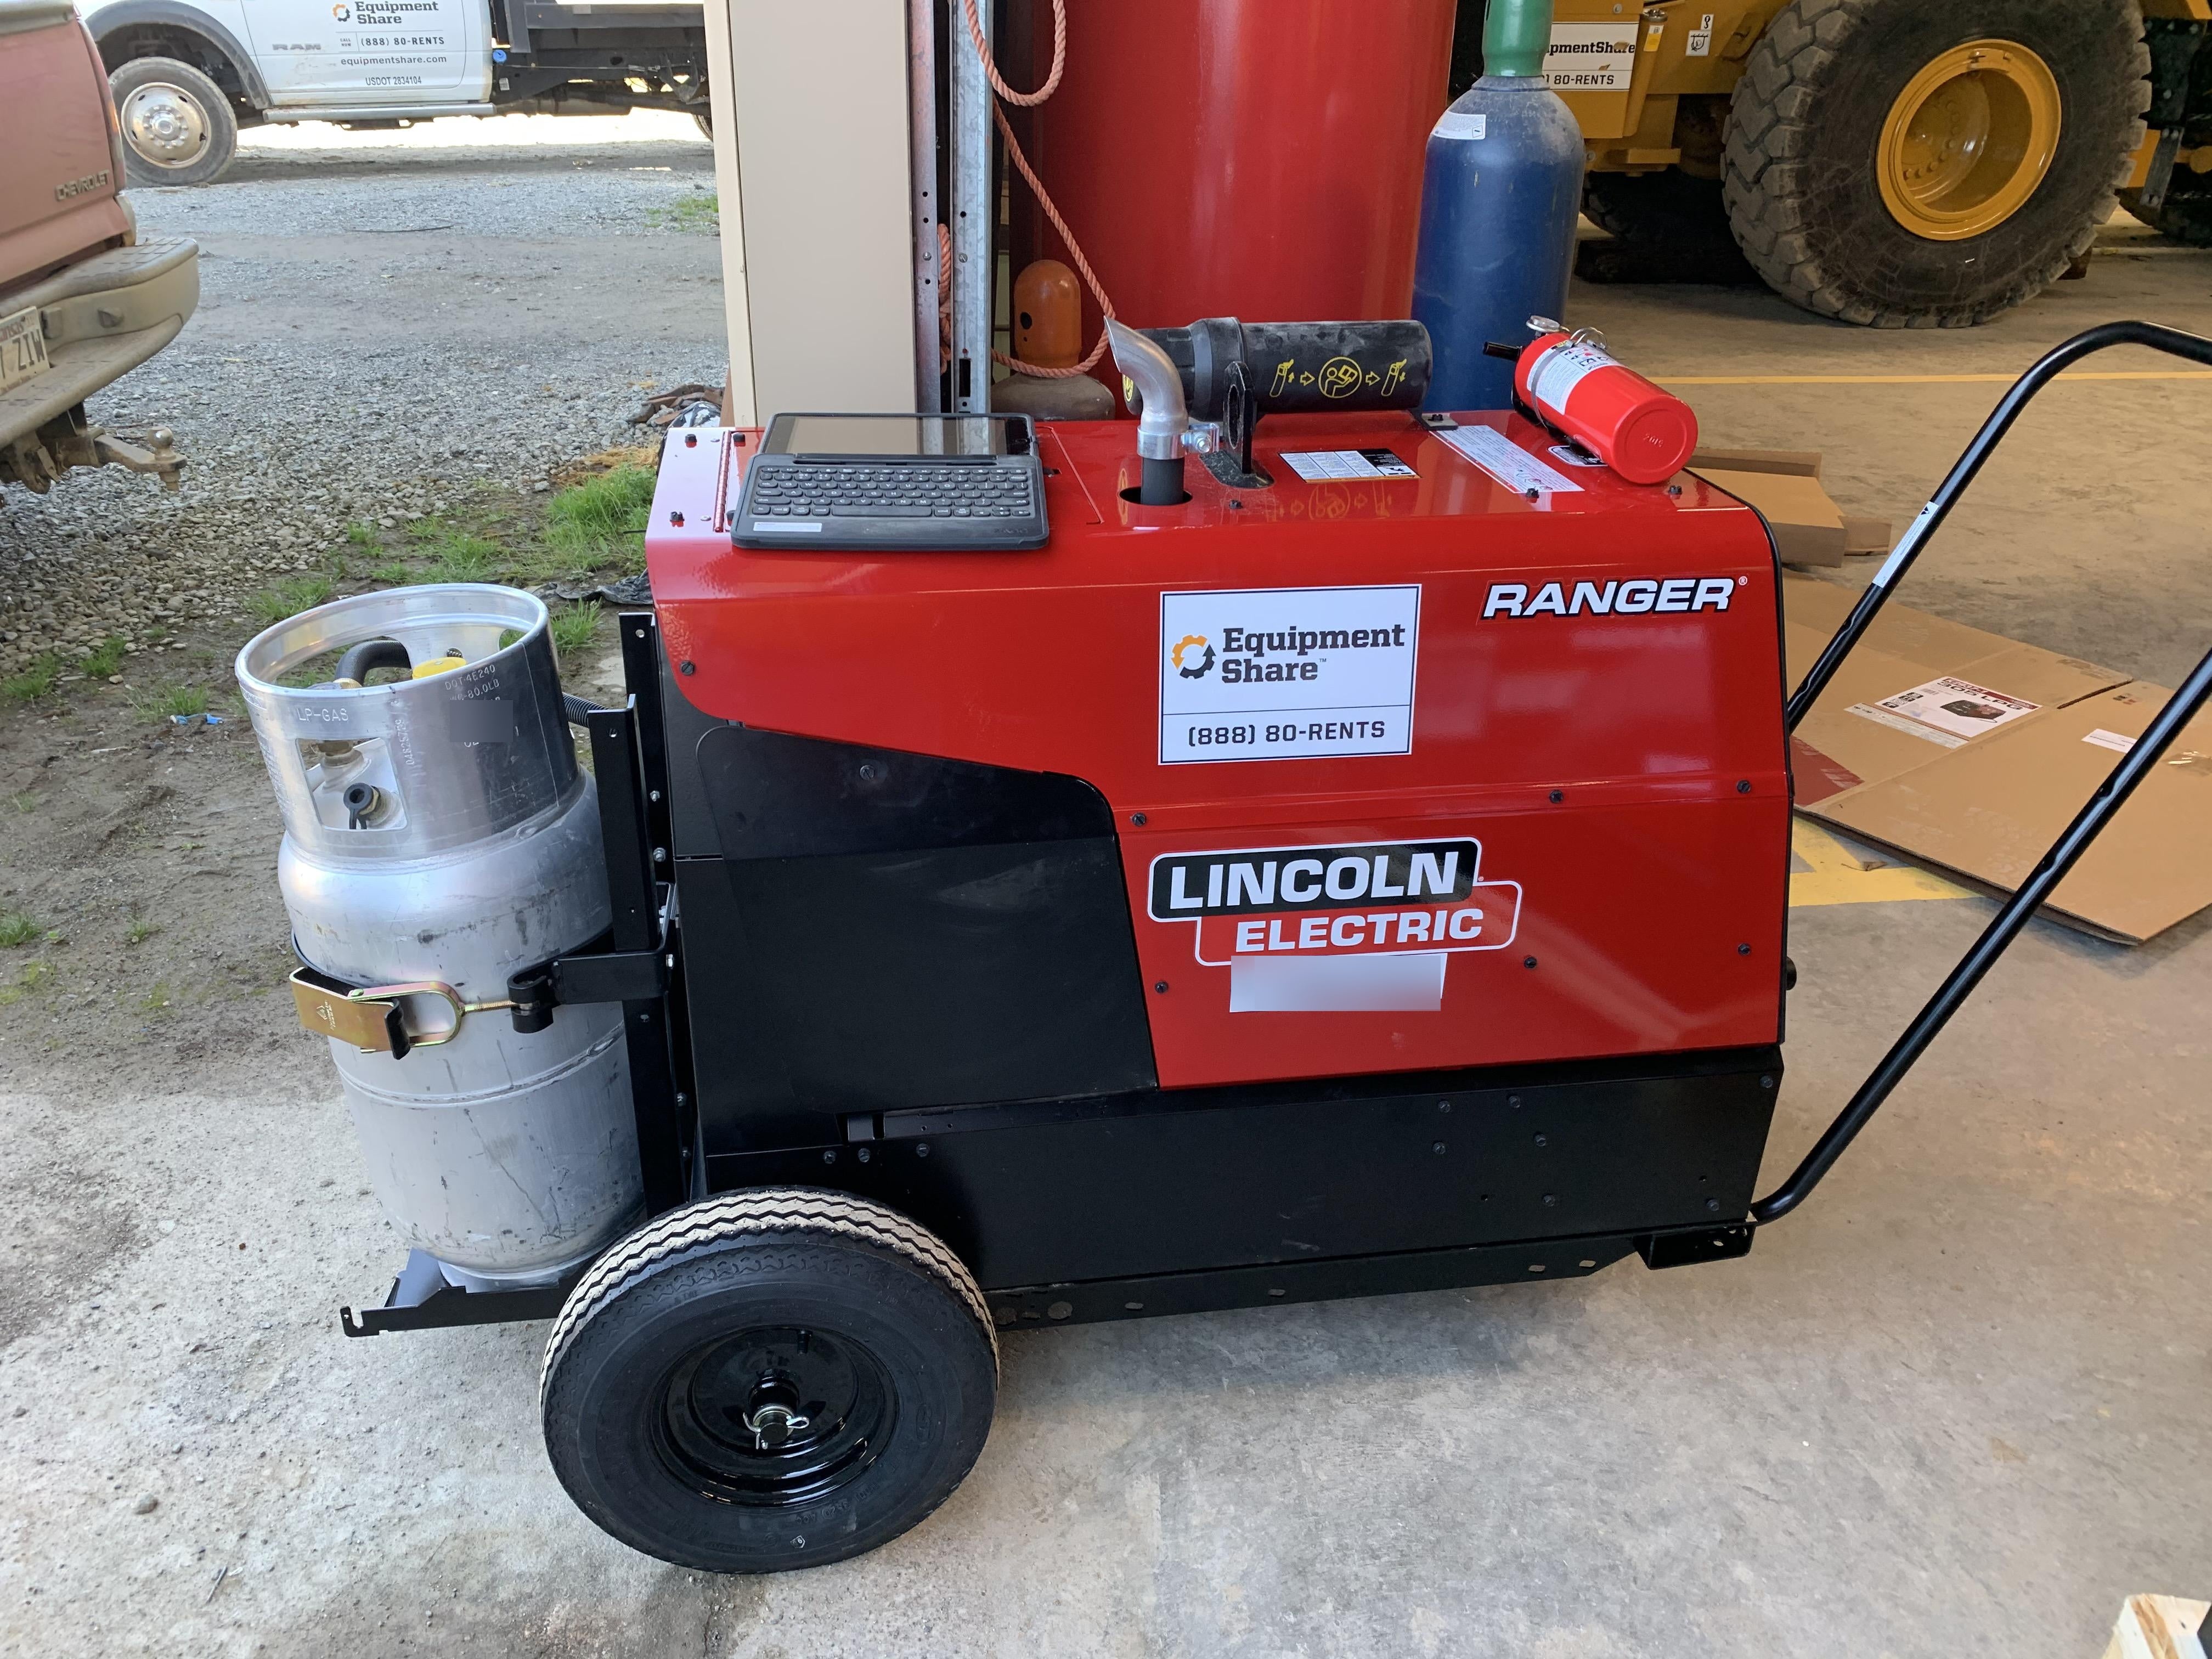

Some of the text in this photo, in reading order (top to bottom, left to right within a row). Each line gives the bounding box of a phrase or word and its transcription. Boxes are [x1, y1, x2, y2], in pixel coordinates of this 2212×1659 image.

[356, 1, 439, 14] Equipment
[357, 14, 403, 24] Share
[360, 37, 445, 46] (888) 80-RENTS
[1548, 41, 1635, 56] pmentShe
[341, 56, 447, 66] equipmentshare.com
[365, 76, 422, 86] USDOT 2834104
[1554, 75, 1615, 84] 80-RENTS
[54, 169, 110, 201] CHEVROLET
[1222, 624, 1406, 657] Equipment
[1937, 682, 1978, 696] 305
[1980, 695, 2023, 710] LPG
[296, 708, 349, 722] LP-GAS
[1188, 720, 1385, 747] (888) 80-RENTS
[1170, 851, 1459, 910] LINCOLN
[1235, 908, 1484, 953] ELECTRIC
